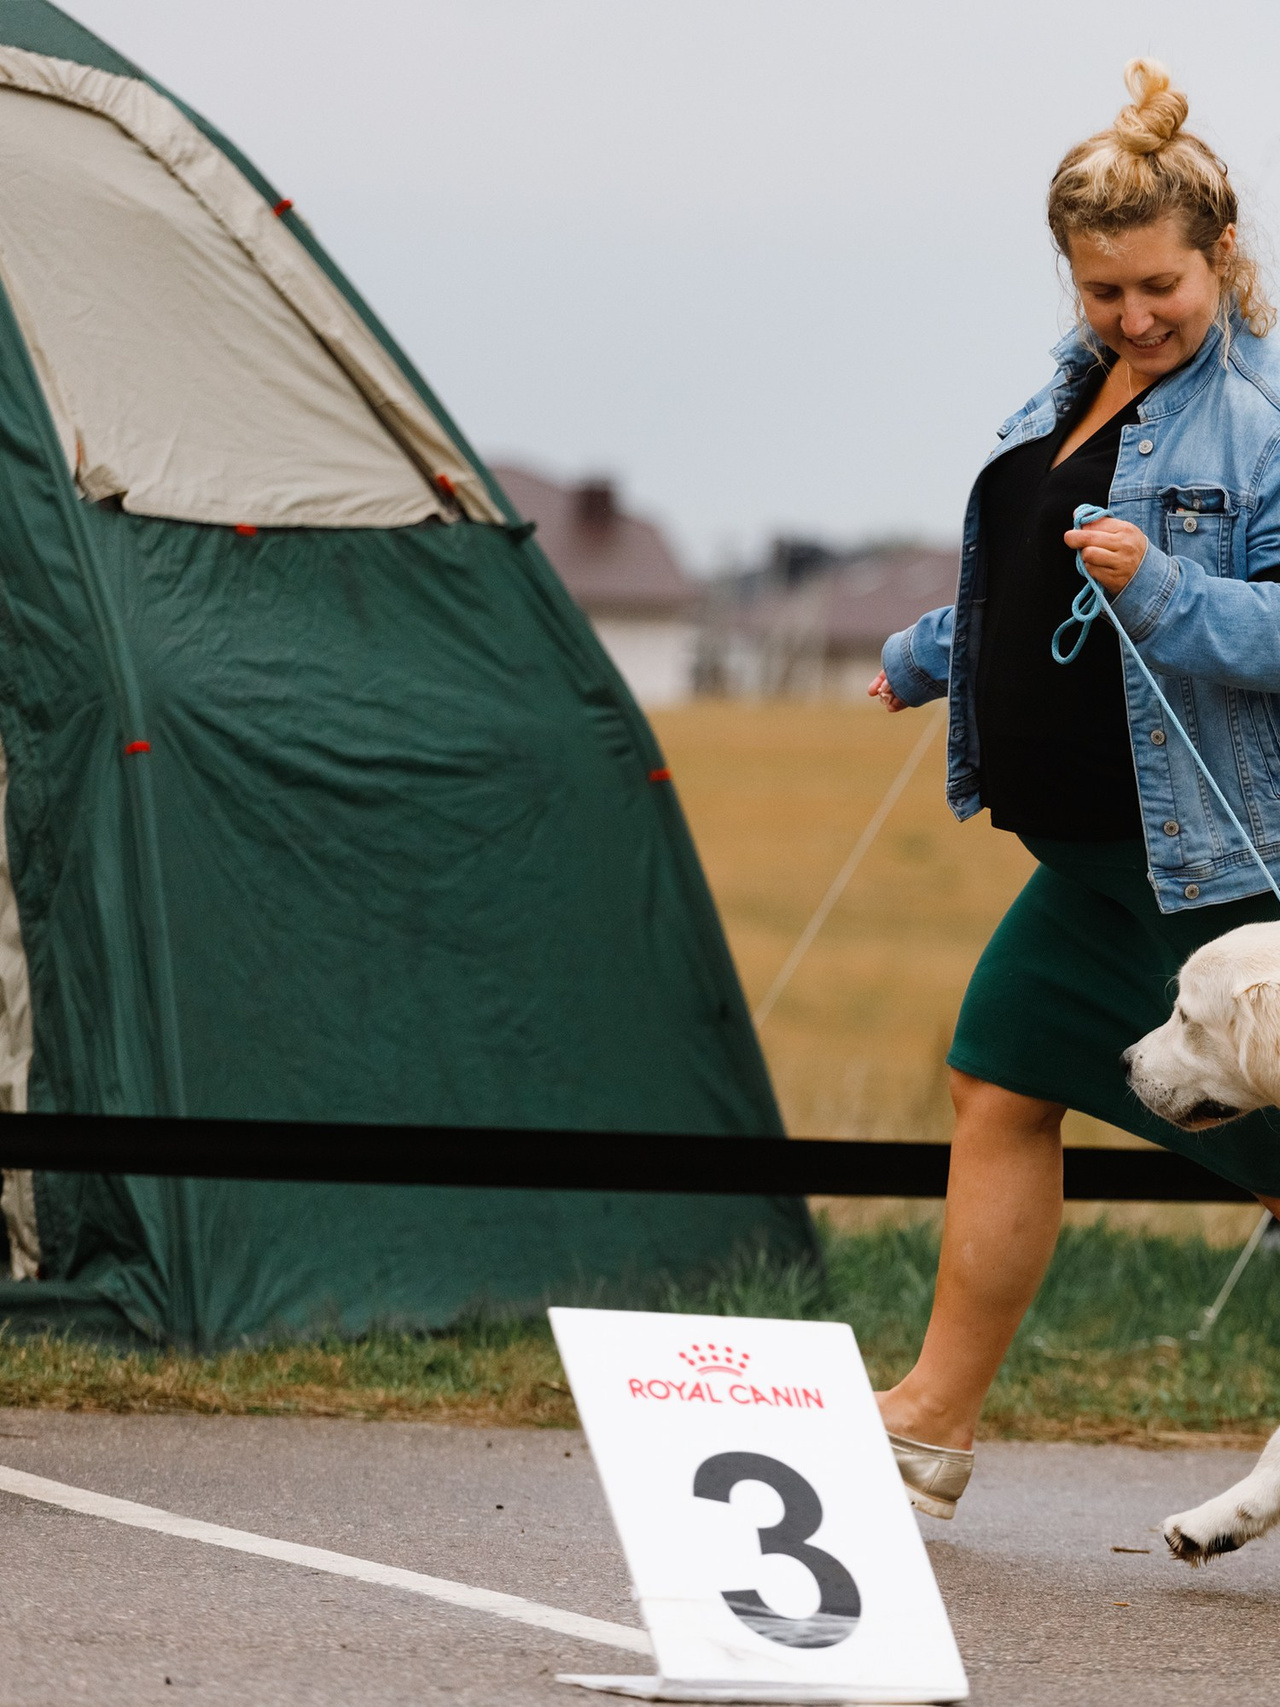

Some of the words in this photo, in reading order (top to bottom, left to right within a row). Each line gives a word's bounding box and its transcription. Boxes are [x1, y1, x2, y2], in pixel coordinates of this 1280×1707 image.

[628, 1378, 722, 1404] ROYAL
[729, 1384, 825, 1409] CANIN
[693, 1451, 862, 1649] 3
